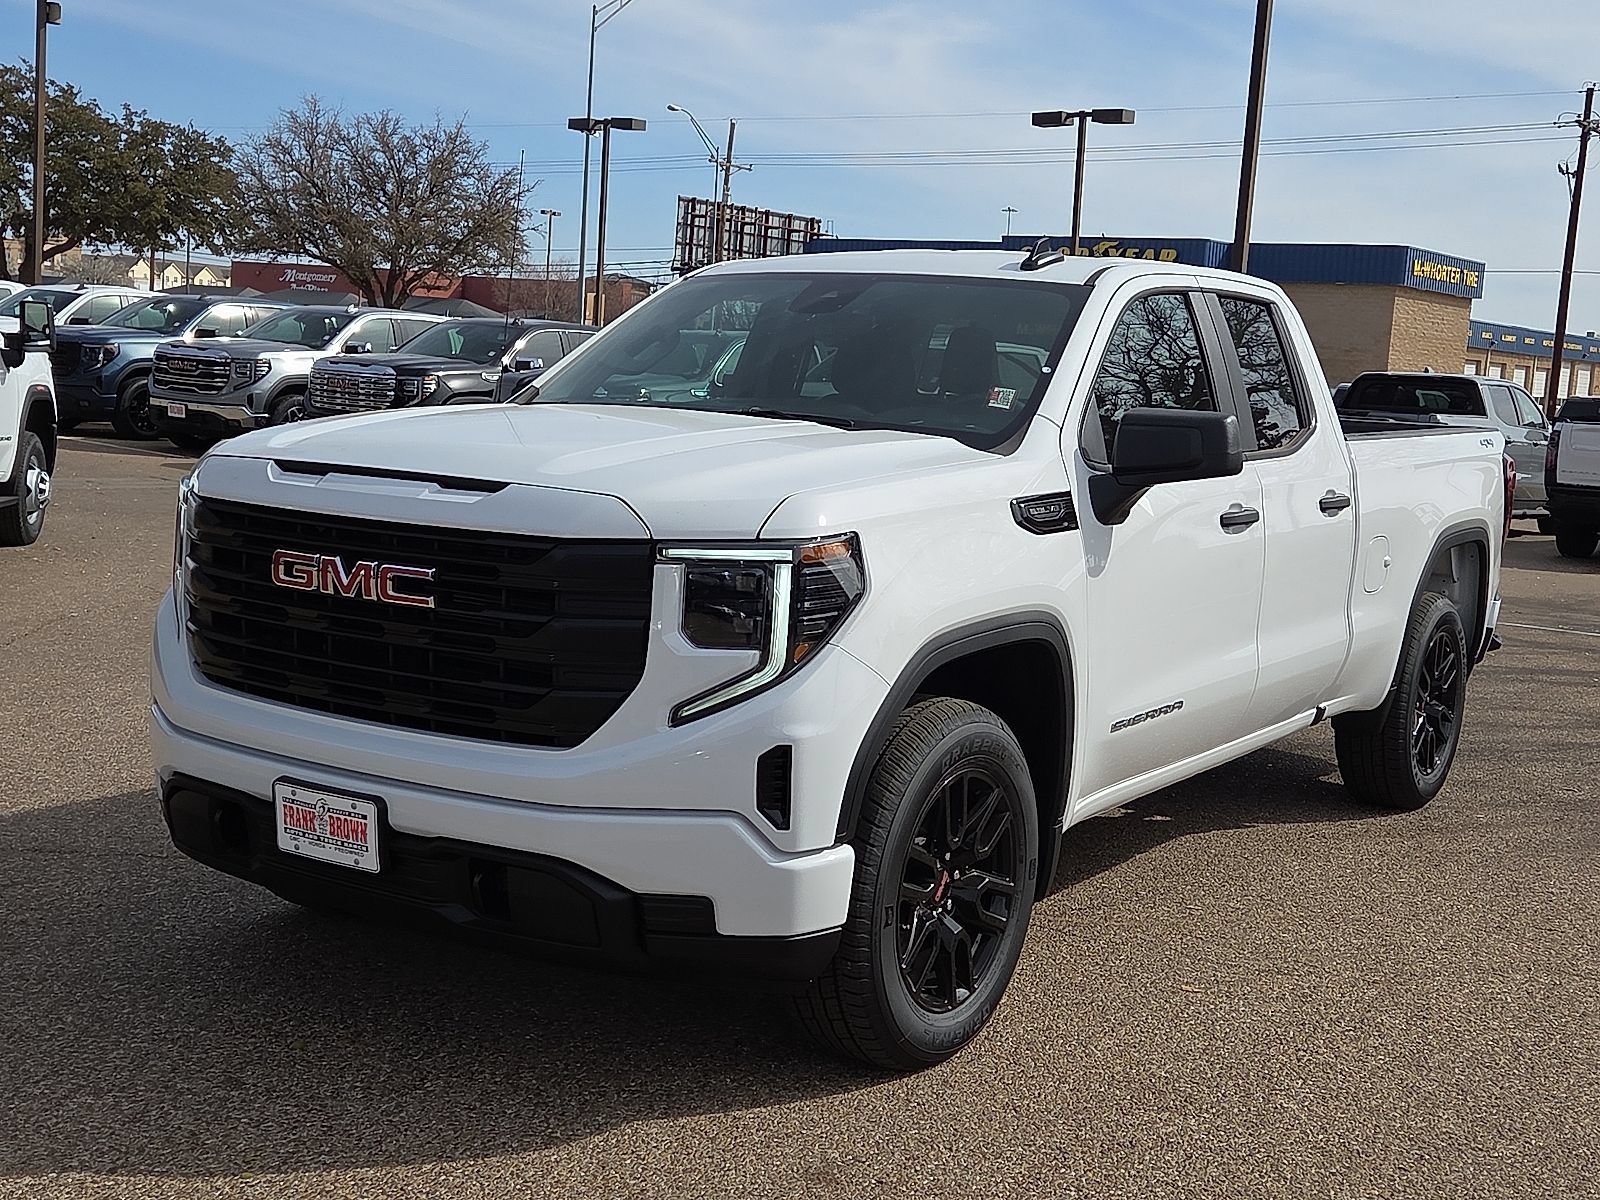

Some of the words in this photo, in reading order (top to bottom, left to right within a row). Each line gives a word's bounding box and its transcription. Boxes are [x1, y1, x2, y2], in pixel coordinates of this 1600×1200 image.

[279, 269, 337, 283] Montgomery
[1462, 269, 1479, 288] TIRE
[271, 549, 436, 609] GMC
[1109, 700, 1184, 733] SIERRA
[283, 803, 317, 833] FRANK
[328, 814, 368, 845] BROWN
